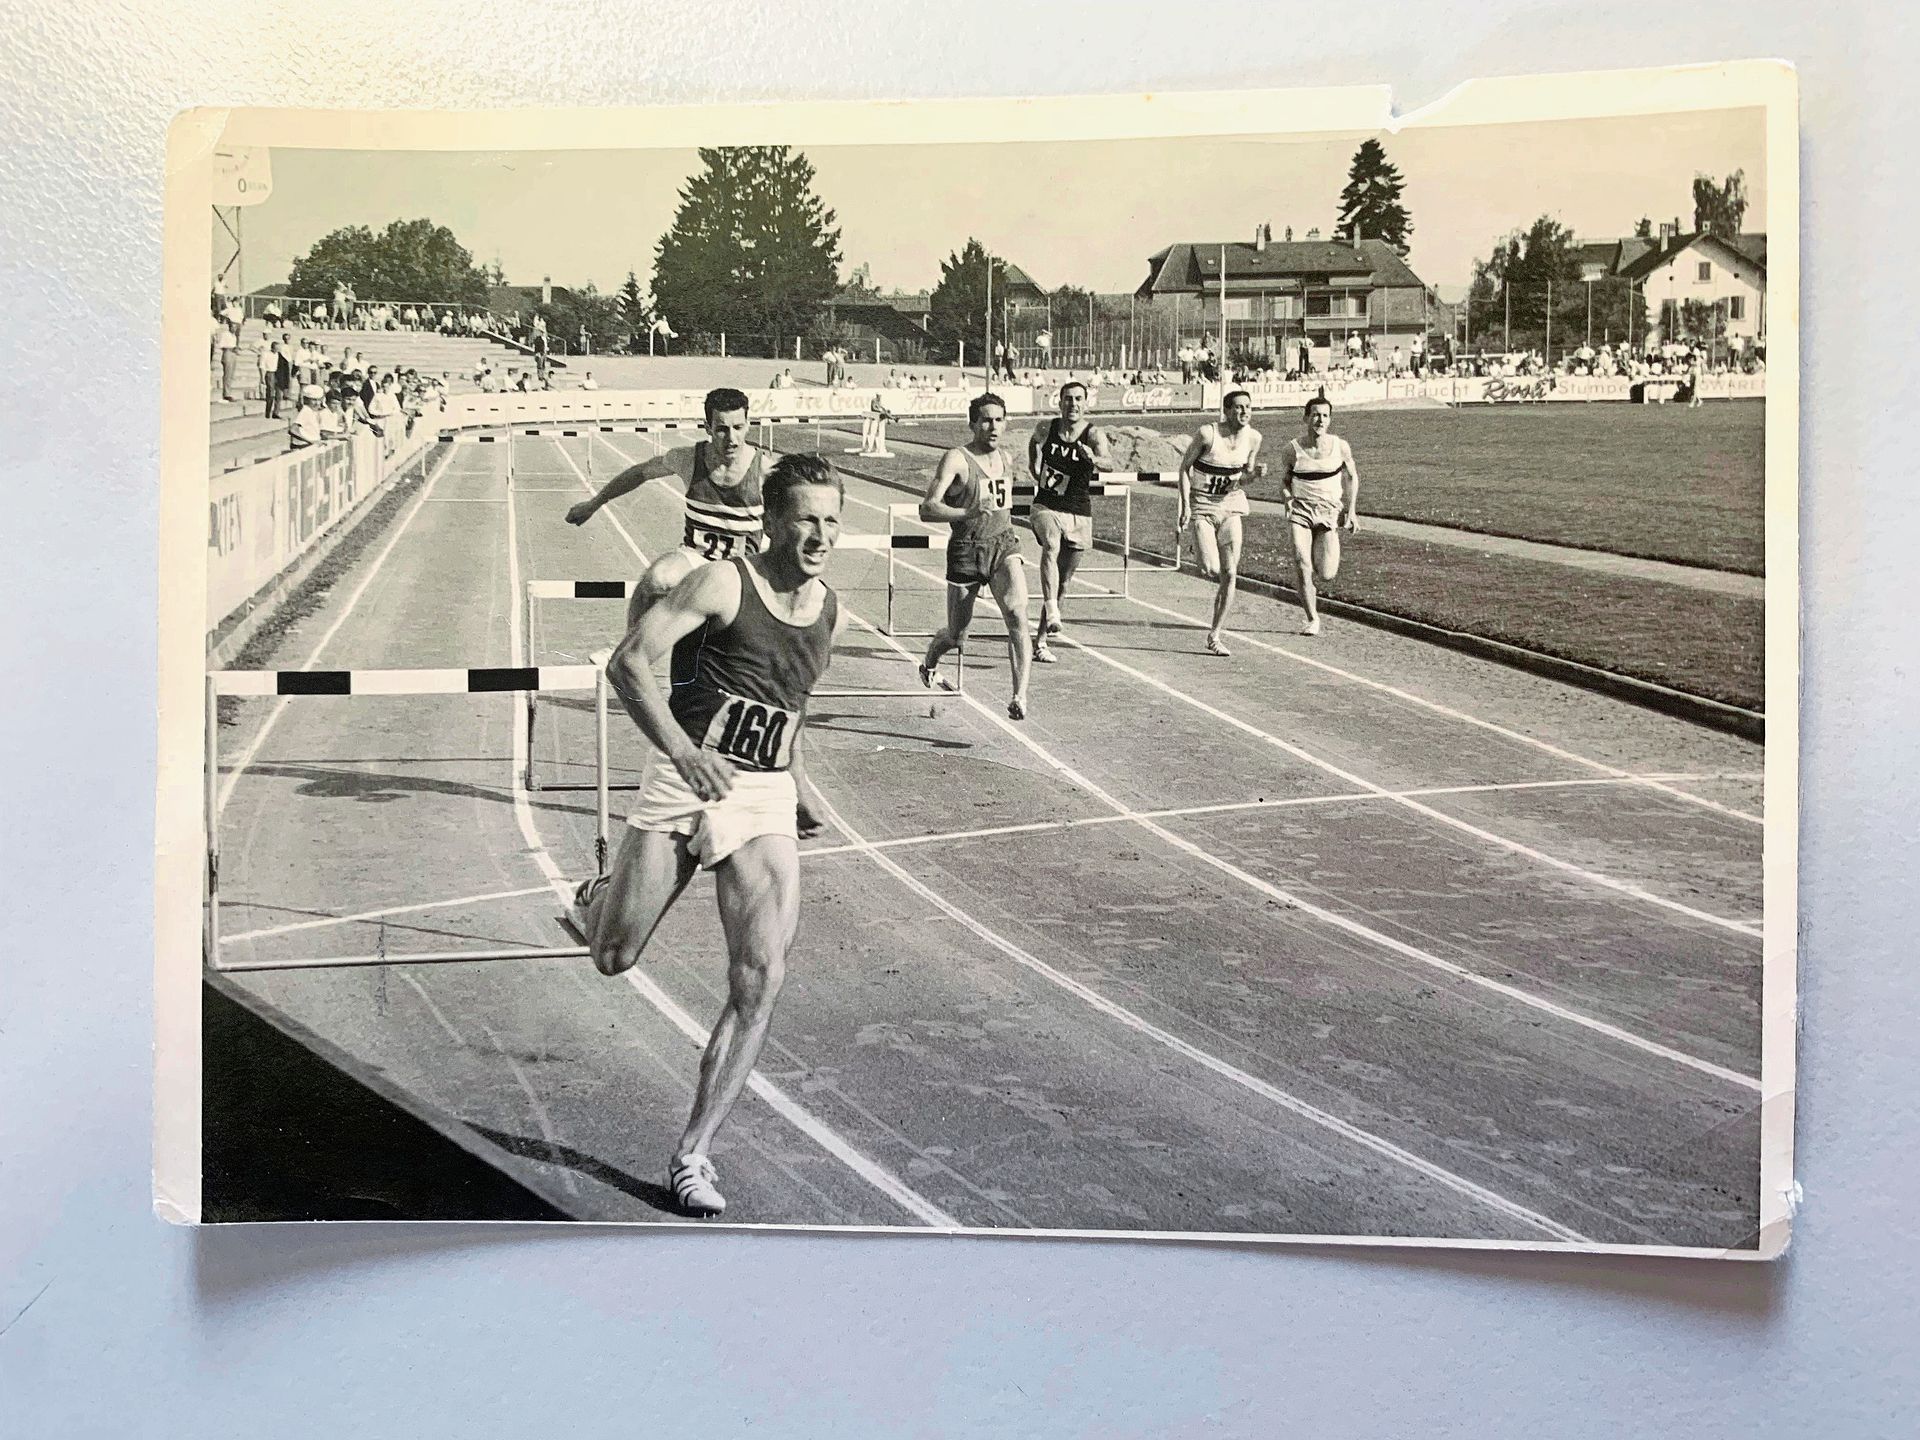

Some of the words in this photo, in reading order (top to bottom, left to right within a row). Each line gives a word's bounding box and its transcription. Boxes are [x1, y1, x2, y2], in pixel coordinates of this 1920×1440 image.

[1558, 381, 1629, 395] Stumpe
[1051, 443, 1079, 461] TVL
[704, 533, 734, 561] 27
[719, 700, 788, 769] 160
